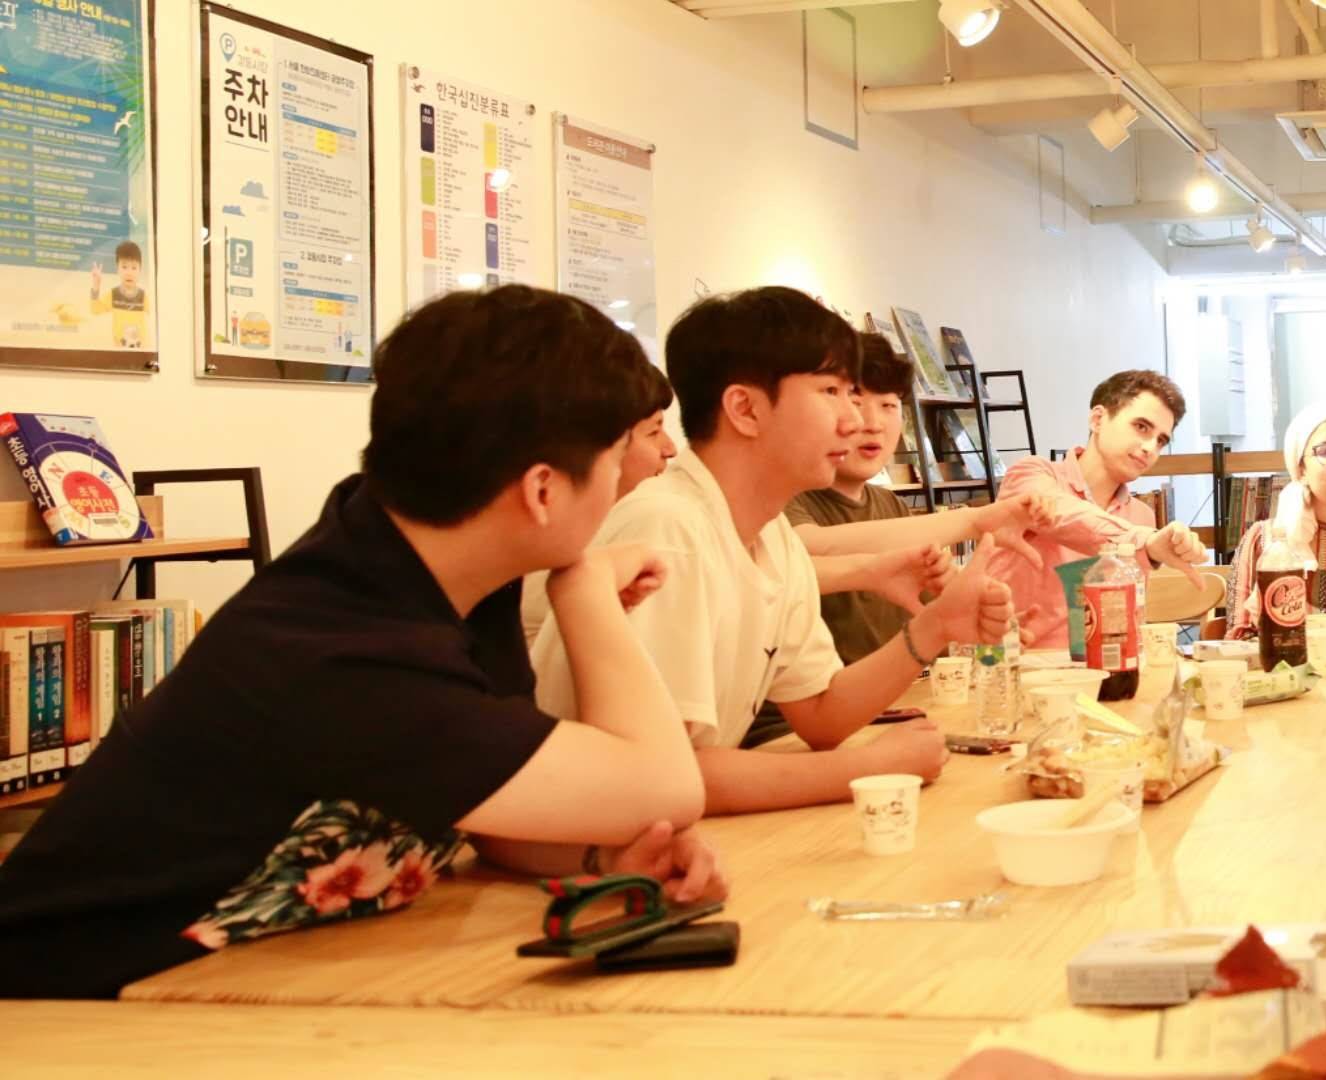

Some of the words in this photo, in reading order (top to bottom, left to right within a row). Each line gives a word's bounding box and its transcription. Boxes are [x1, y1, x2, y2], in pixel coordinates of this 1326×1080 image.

[223, 68, 269, 109] 주차
[436, 82, 510, 119] 한국십진분류표
[224, 105, 268, 143] 안내
[1281, 601, 1303, 616] Cola
